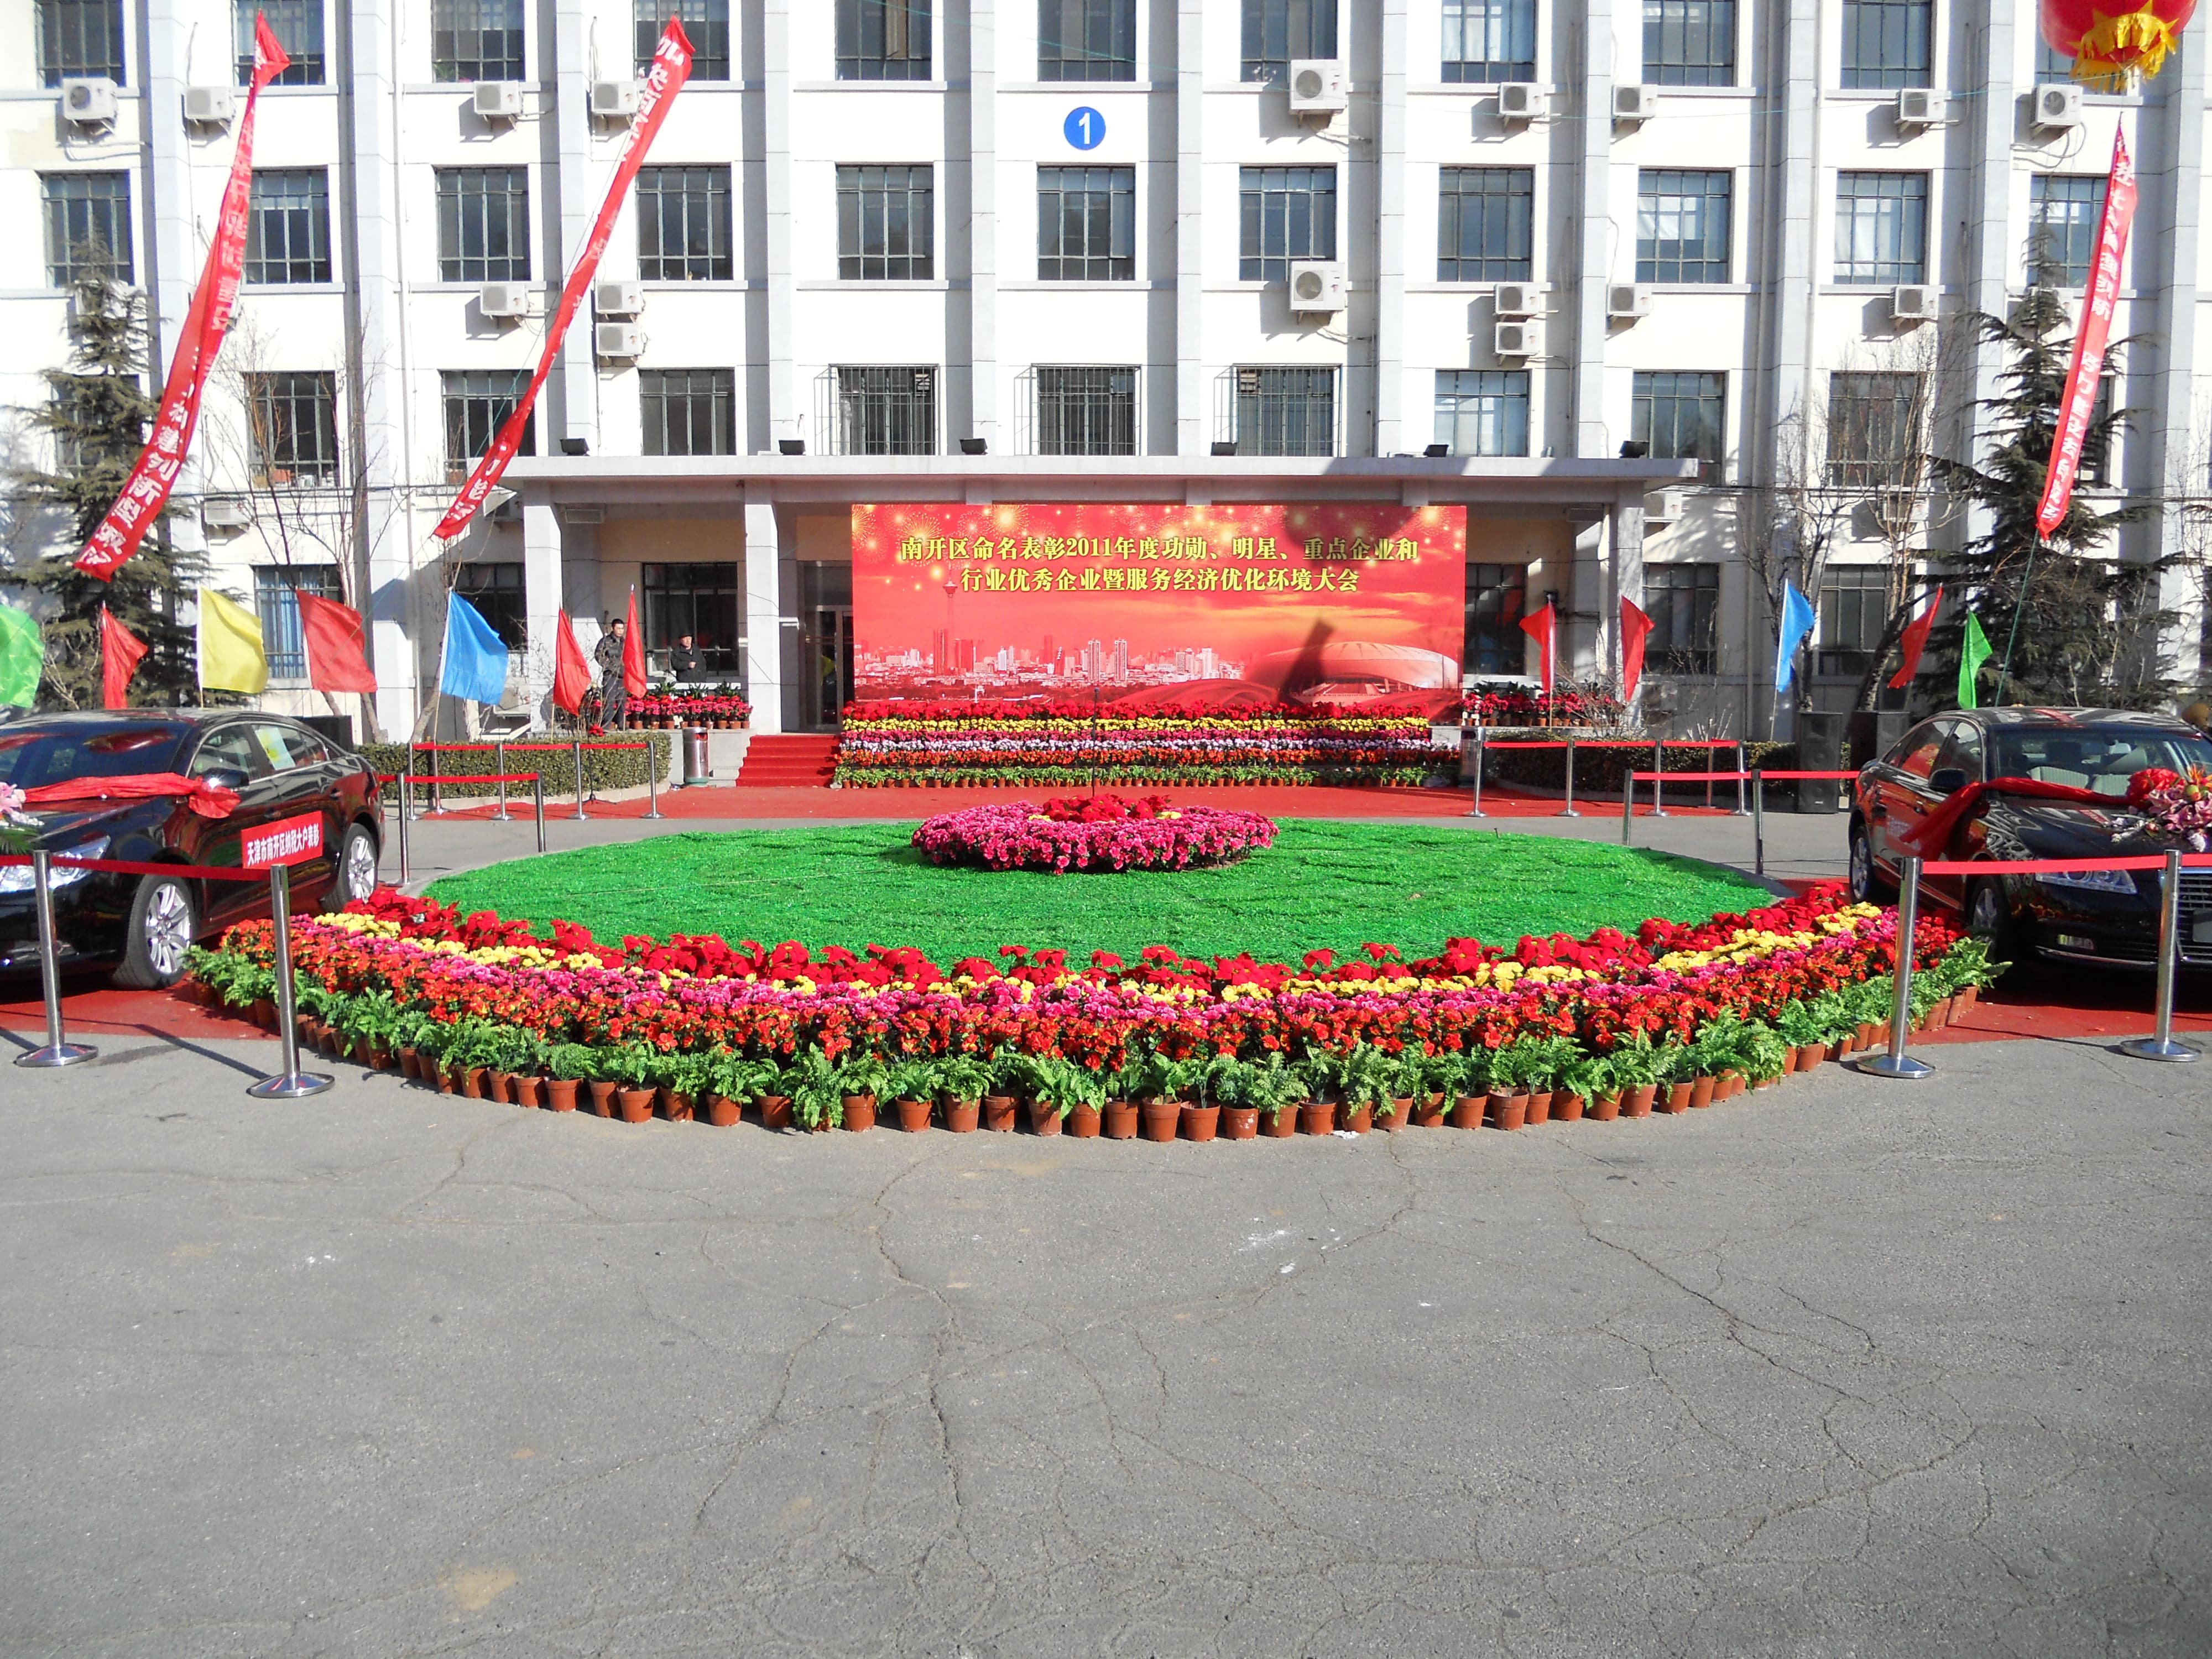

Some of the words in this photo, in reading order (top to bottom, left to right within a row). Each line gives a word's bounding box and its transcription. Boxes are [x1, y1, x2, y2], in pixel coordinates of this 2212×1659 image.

[1078, 112, 1090, 144] 1
[900, 536, 1418, 561] 南开区命名表彰2011年度功勋、明星、重点企业和
[961, 567, 1359, 592] 行业优秀企业暨服务经济优化环境大会
[247, 822, 319, 867] 天津市南开区纳税大户表彰
